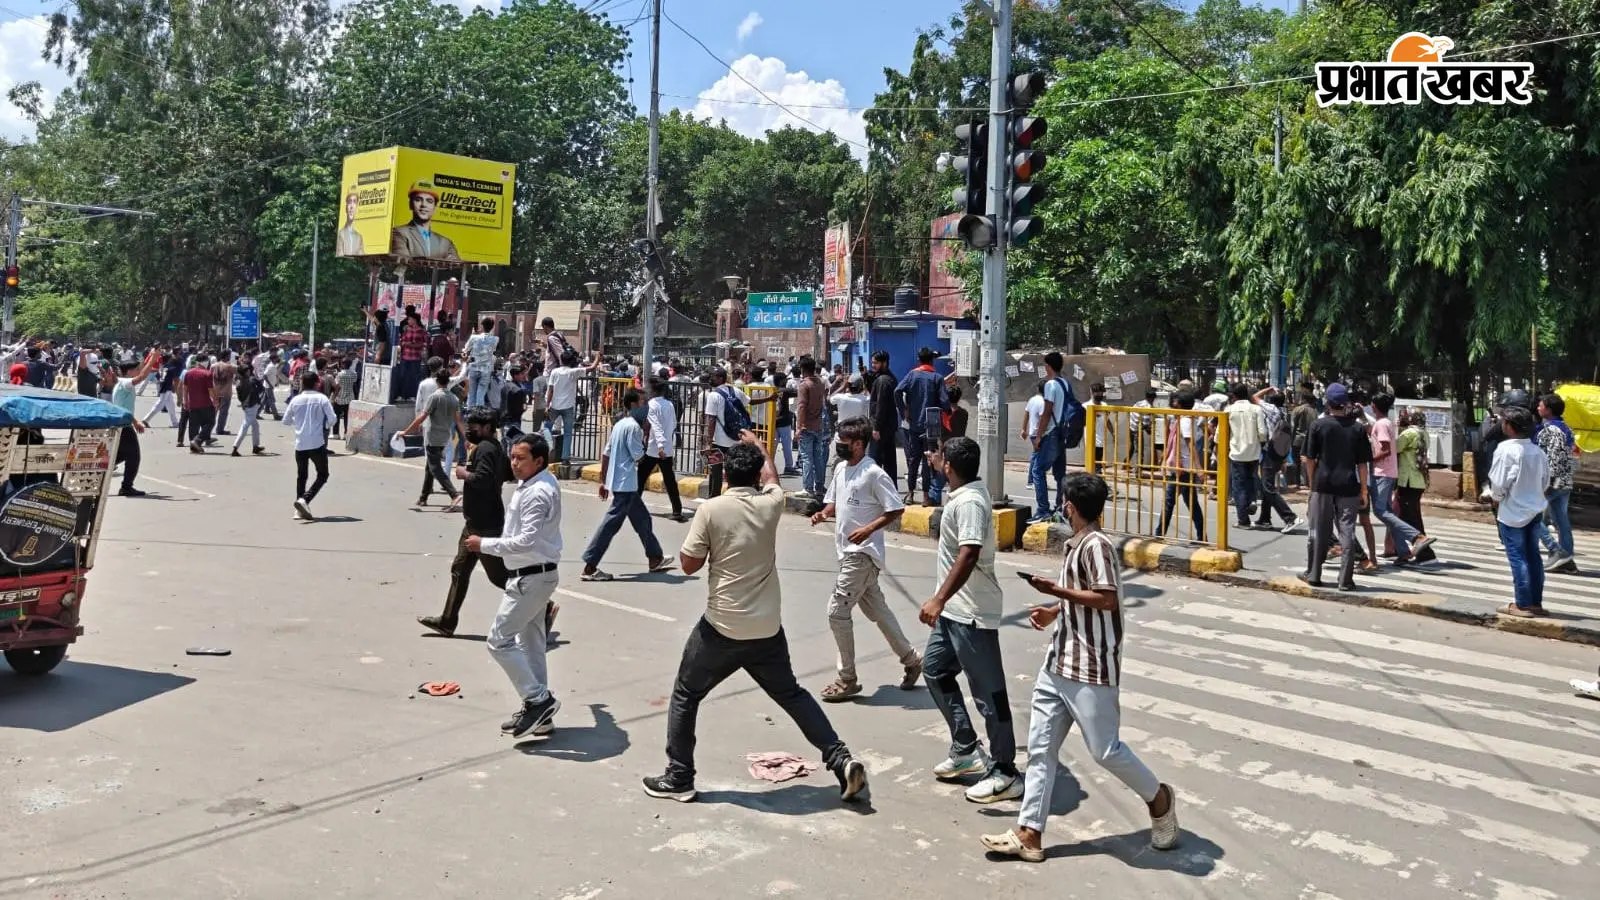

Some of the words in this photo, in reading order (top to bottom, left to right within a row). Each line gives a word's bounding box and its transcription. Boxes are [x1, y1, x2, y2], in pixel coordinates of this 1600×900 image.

[435, 177, 460, 187] INDIA'S
[477, 183, 501, 193] CEMENT
[360, 188, 386, 200] UltraTech
[440, 192, 497, 209] UltraTech
[441, 203, 495, 214] CEMENT
[753, 307, 771, 323] गेट
